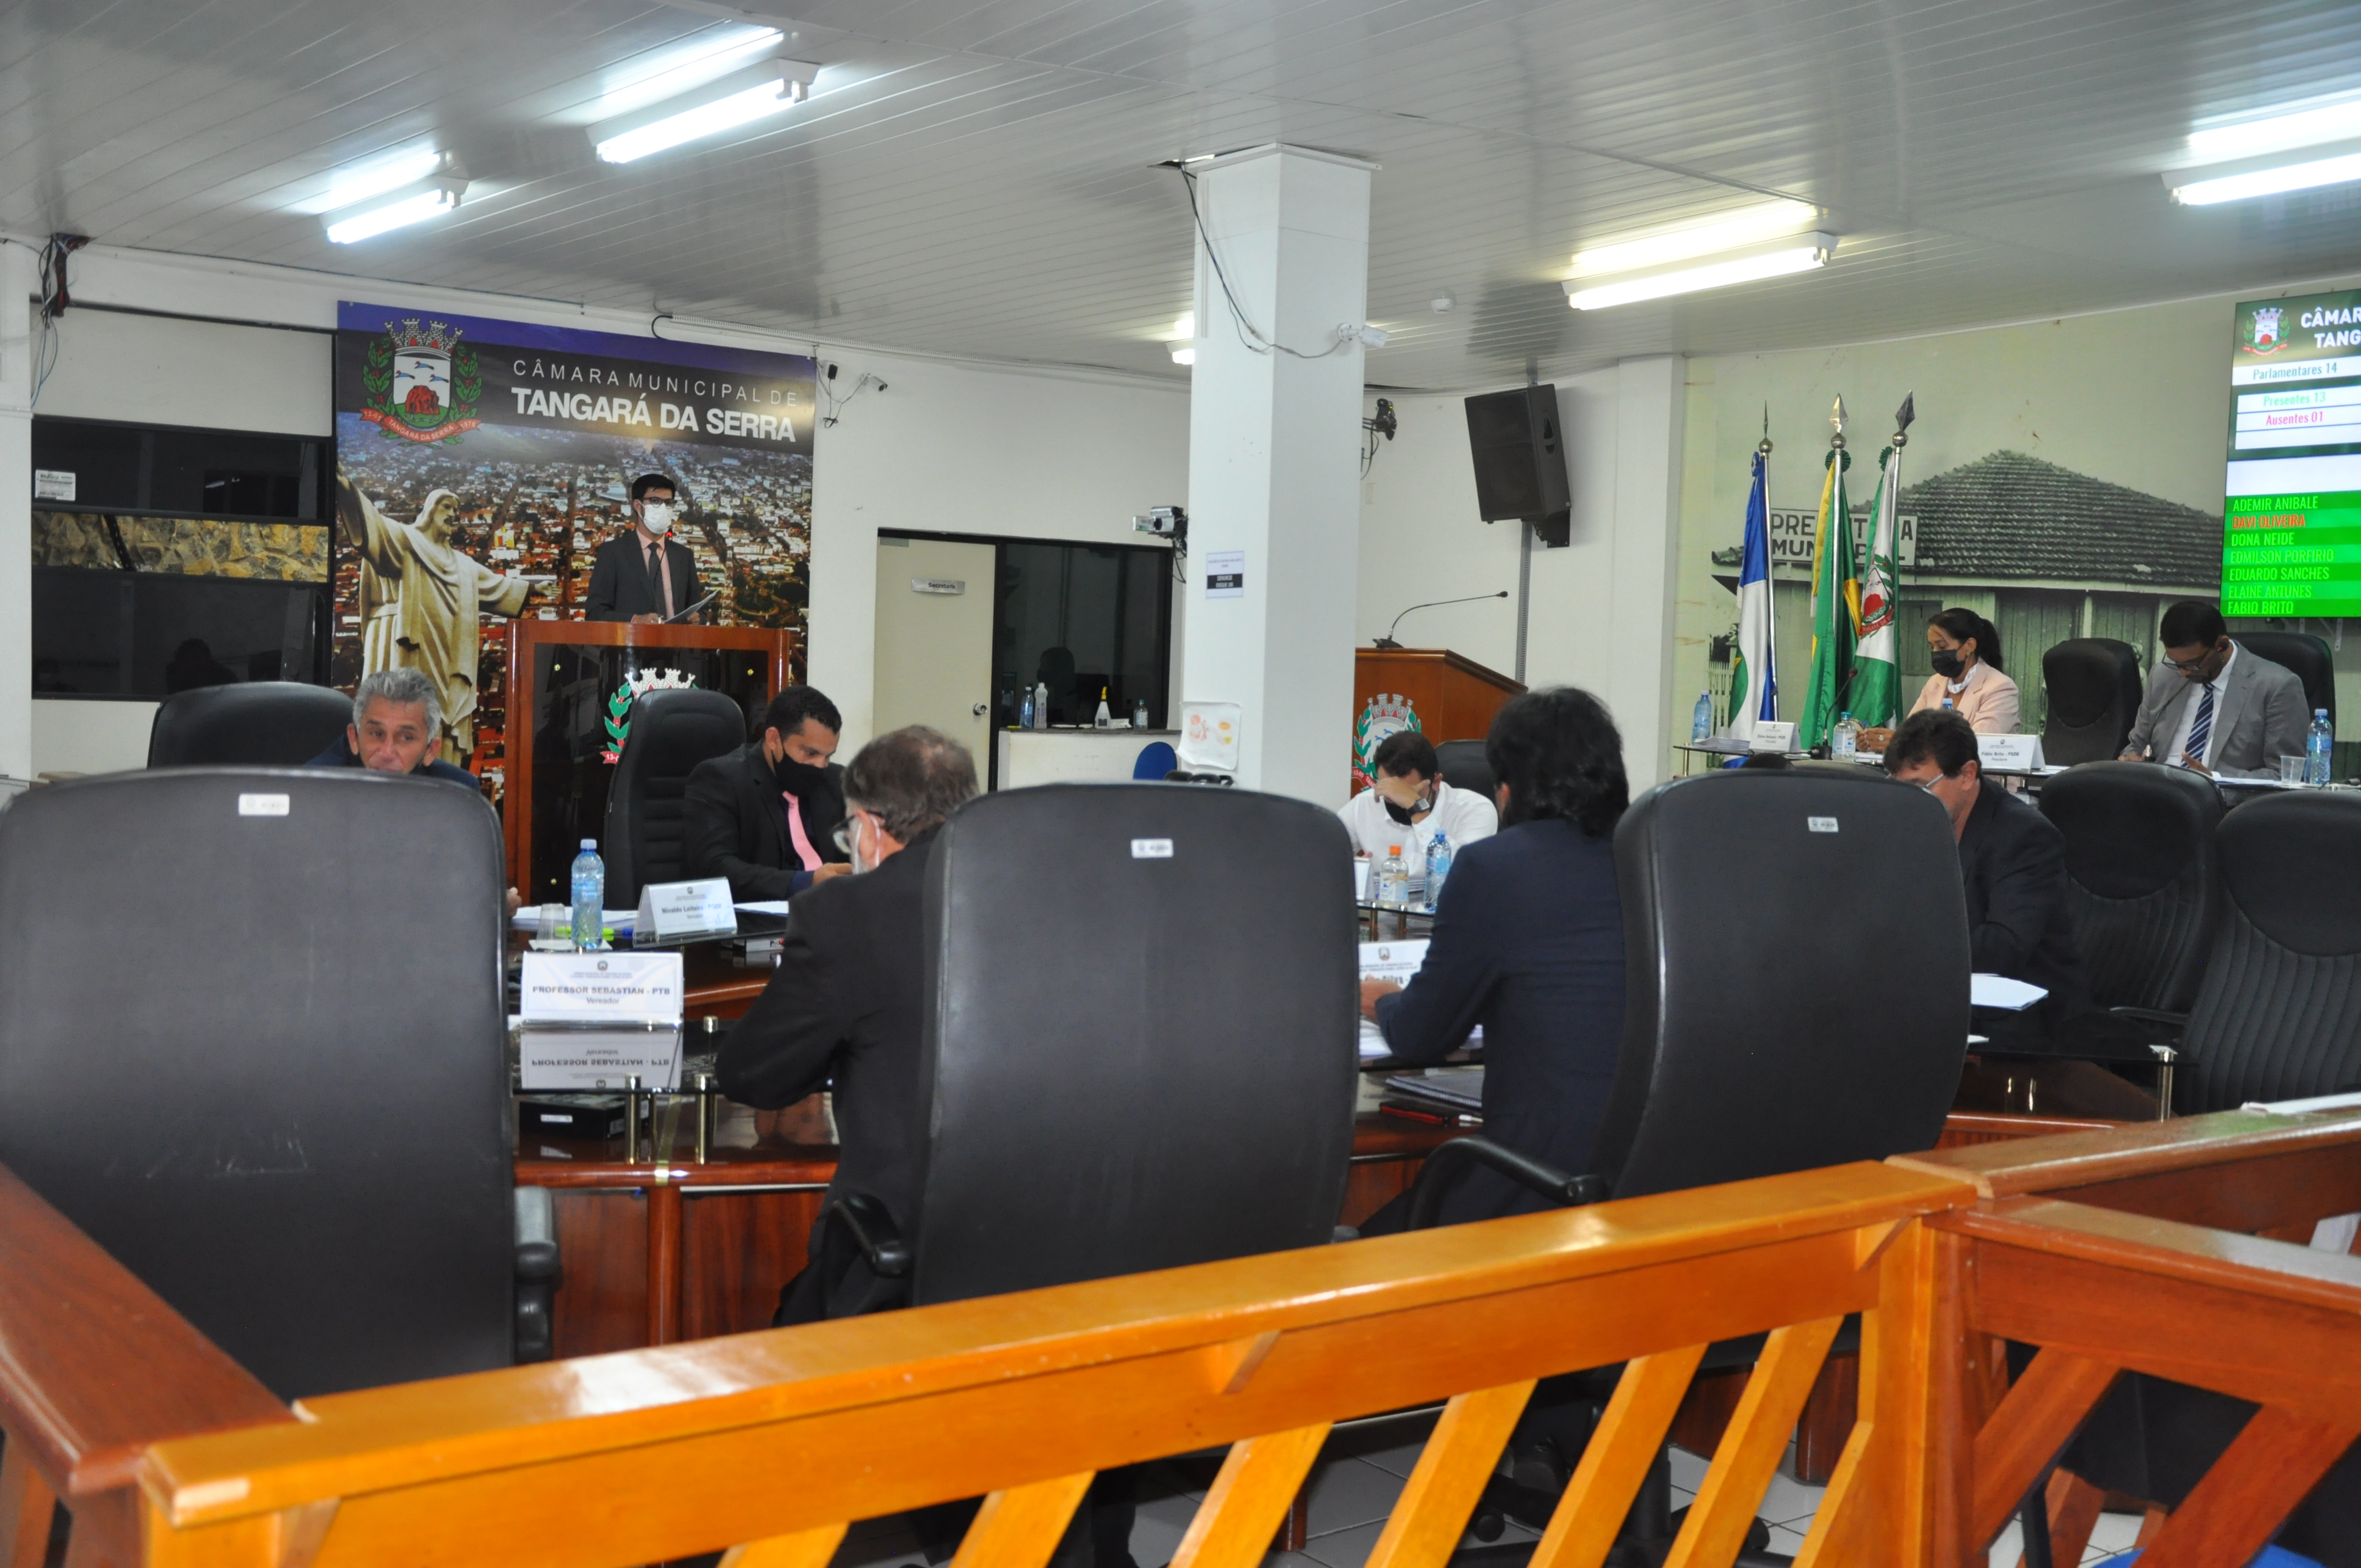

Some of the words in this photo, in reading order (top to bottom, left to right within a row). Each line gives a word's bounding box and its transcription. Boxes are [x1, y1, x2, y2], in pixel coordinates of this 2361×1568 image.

[2253, 364, 2322, 380] Parlamentares
[2326, 362, 2337, 373] 14
[513, 358, 620, 386] CÂMARA
[628, 372, 761, 402] MUNICIPAL
[771, 386, 797, 407] DE
[2264, 394, 2310, 406] Presentes
[2314, 391, 2326, 402] 13
[511, 387, 651, 427] TANGARÁ
[660, 402, 699, 432] DA
[706, 407, 796, 443] SERRA
[2266, 414, 2308, 426] Ausentes
[2311, 411, 2323, 422] 01
[388, 419, 418, 439] TANGARÁ
[431, 425, 454, 439] SERRA
[460, 420, 476, 429] 1976
[2233, 498, 2272, 511] ADEMIR
[2275, 496, 2318, 510] ANIBALE
[2233, 516, 2255, 529] DAVI
[2259, 514, 2305, 527] OLIVEIRA
[2232, 533, 2260, 546] DONA
[2264, 532, 2294, 545] NEIDE
[2231, 551, 2281, 563] EDMILSON
[2285, 549, 2334, 562] PORFIRIO
[2230, 568, 2277, 580] EDUARDO
[2281, 567, 2329, 580] SANCHES
[2229, 585, 2262, 598] ELAINE
[2266, 585, 2313, 597] ANTUNES
[2228, 601, 2258, 613] FABIO
[2262, 601, 2294, 613] BRITO
